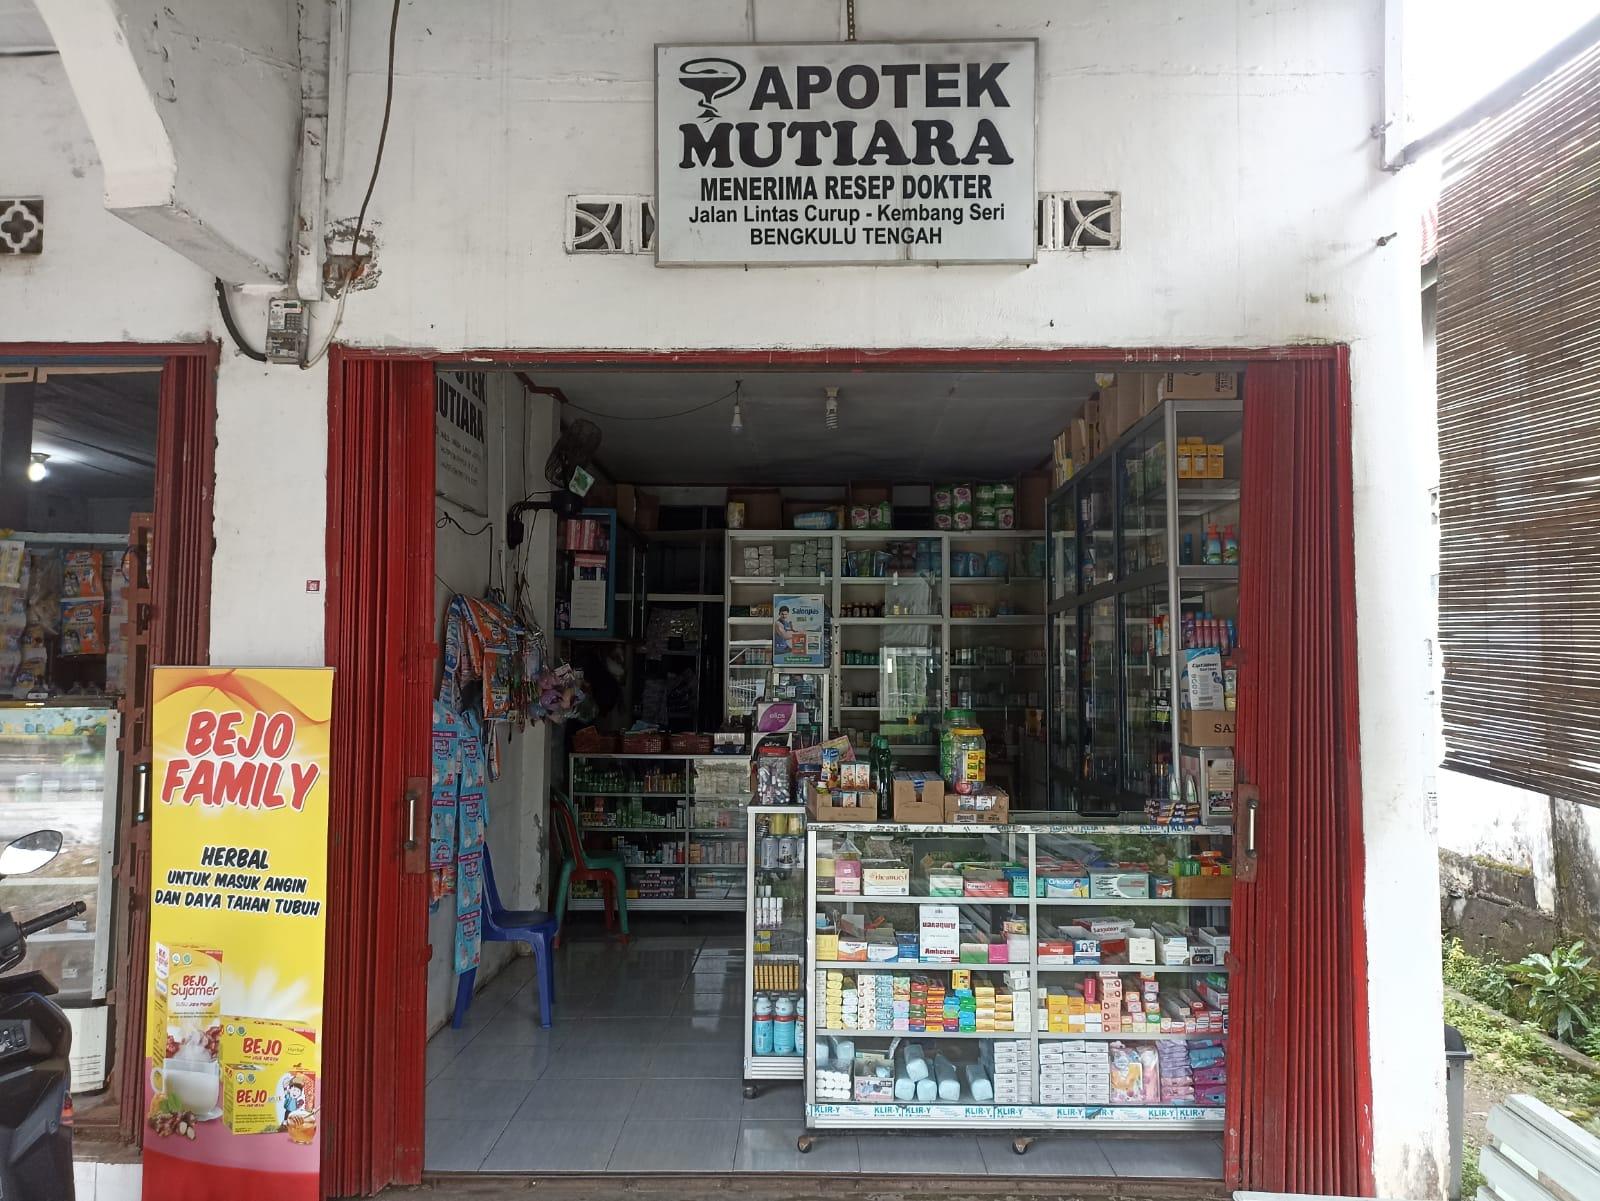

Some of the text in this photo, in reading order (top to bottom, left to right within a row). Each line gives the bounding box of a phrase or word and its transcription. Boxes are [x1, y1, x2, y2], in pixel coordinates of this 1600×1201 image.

[749, 62, 1011, 110] APOTEK
[678, 118, 1014, 169] MUTIARA
[700, 174, 993, 201] MENERIMA RESEP DOKTER
[688, 204, 738, 224] Jalan
[743, 204, 799, 223] Lintas
[804, 204, 860, 226] Curup
[877, 203, 964, 225] Kembang
[969, 202, 1005, 221] Seri
[750, 226, 942, 245] BENGKULU TENGAH
[185, 710, 295, 759] BEJO
[161, 759, 320, 811] FAMILY
[201, 846, 270, 869] HERBAL
[167, 870, 307, 893] UNTUK MASUK ANGIN
[154, 890, 320, 916] DAN DAYA TAHAN TUBUH
[182, 975, 208, 987] BEJO
[242, 1037, 283, 1057] BEJO
[236, 1089, 267, 1104] BEJO
[814, 1106, 840, 1115] KLIR-Y
[874, 1106, 900, 1115] KLIR-Y
[905, 1106, 932, 1115] KLIR-Y
[965, 1107, 991, 1115] KLIR-Y
[997, 1108, 1023, 1116] KLIR-Y
[1056, 1108, 1083, 1116] KLIR-Y
[1148, 1109, 1175, 1117] KLIR-Y
[1179, 1109, 1206, 1117] KLIR-Y
